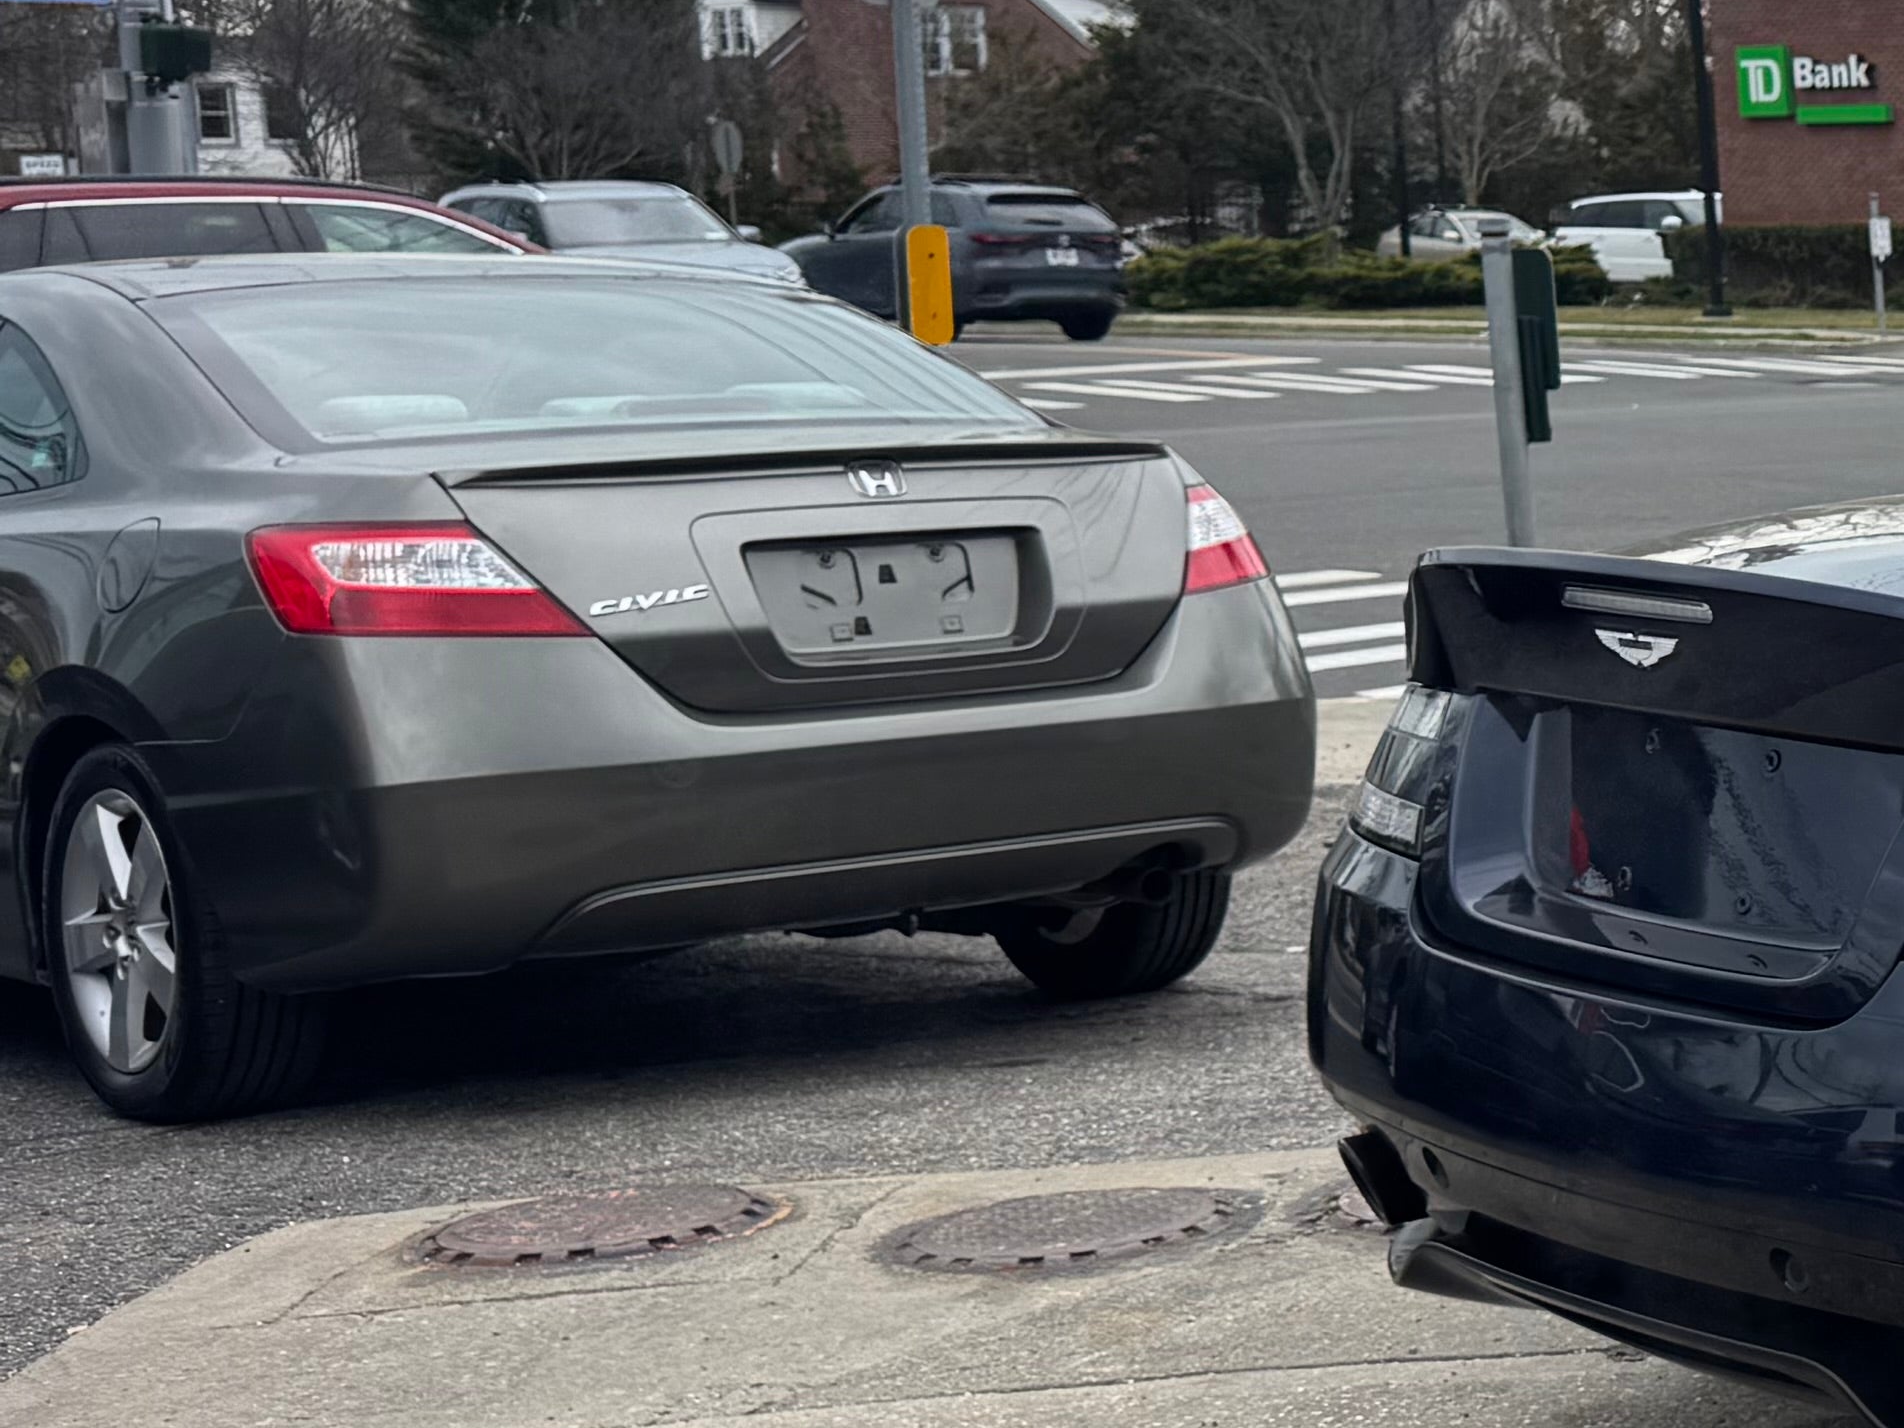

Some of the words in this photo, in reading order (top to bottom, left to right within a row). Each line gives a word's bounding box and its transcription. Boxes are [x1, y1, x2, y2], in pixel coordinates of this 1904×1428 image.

[1739, 58, 1782, 103] TD
[1792, 53, 1871, 89] Bank
[588, 583, 709, 617] CIVIC
